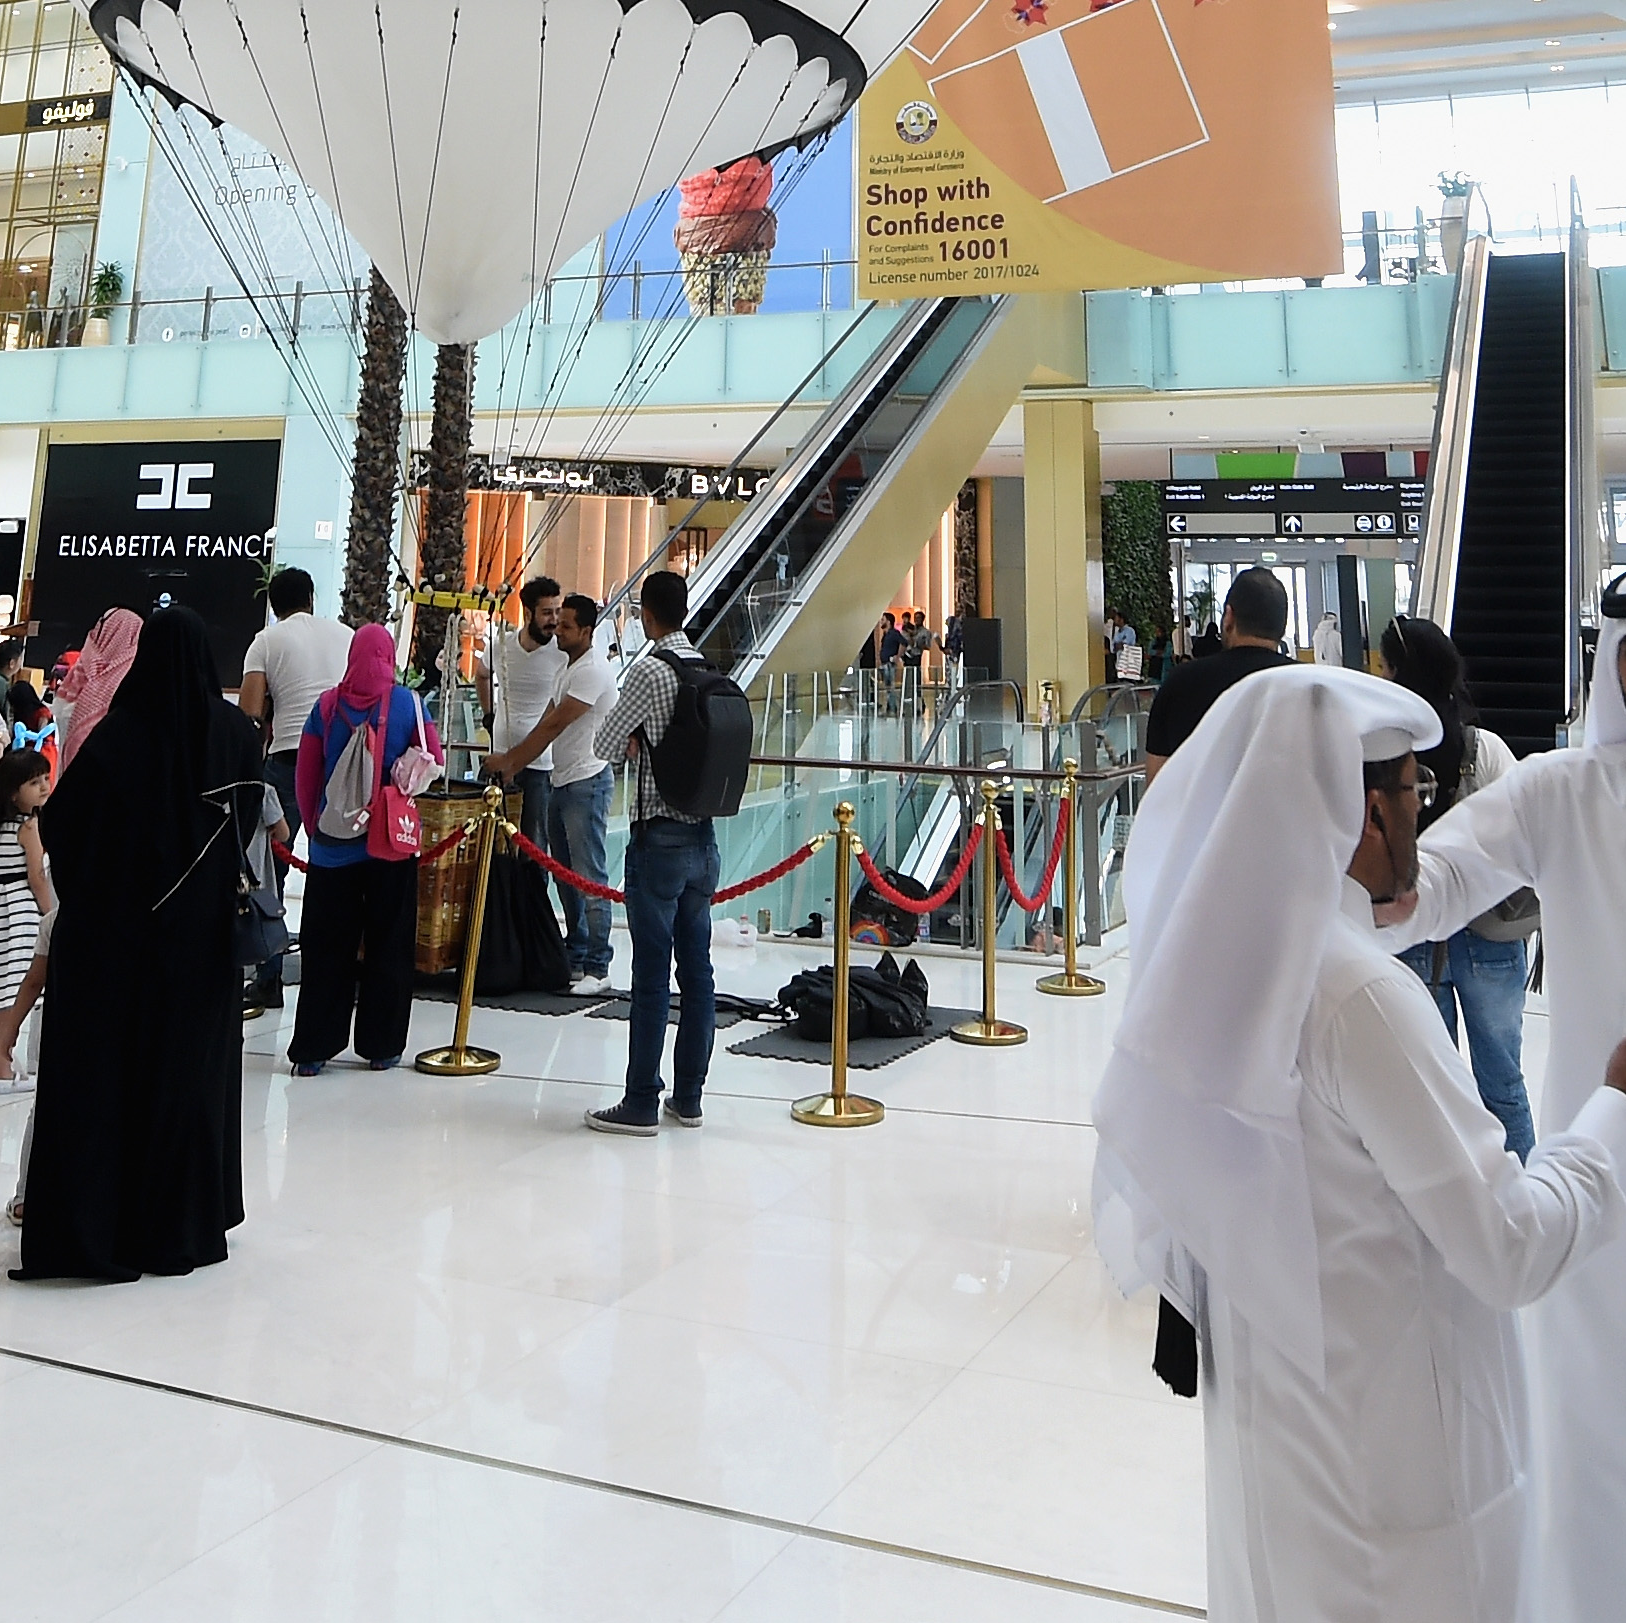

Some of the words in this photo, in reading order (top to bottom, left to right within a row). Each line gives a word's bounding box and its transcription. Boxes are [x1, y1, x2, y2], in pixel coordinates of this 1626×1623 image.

[214, 184, 298, 207] Opening
[866, 182, 929, 209] Shop
[937, 176, 991, 202] with
[866, 211, 1005, 238] Confidence
[868, 244, 883, 253] For
[885, 243, 930, 255] Complaints
[868, 256, 884, 266] and
[885, 254, 935, 267] Suggestions
[939, 237, 1009, 263] 16001
[869, 270, 917, 285] License
[919, 268, 969, 283] number
[973, 263, 1041, 280] 2017/1024
[58, 534, 176, 558] ELISABETTA
